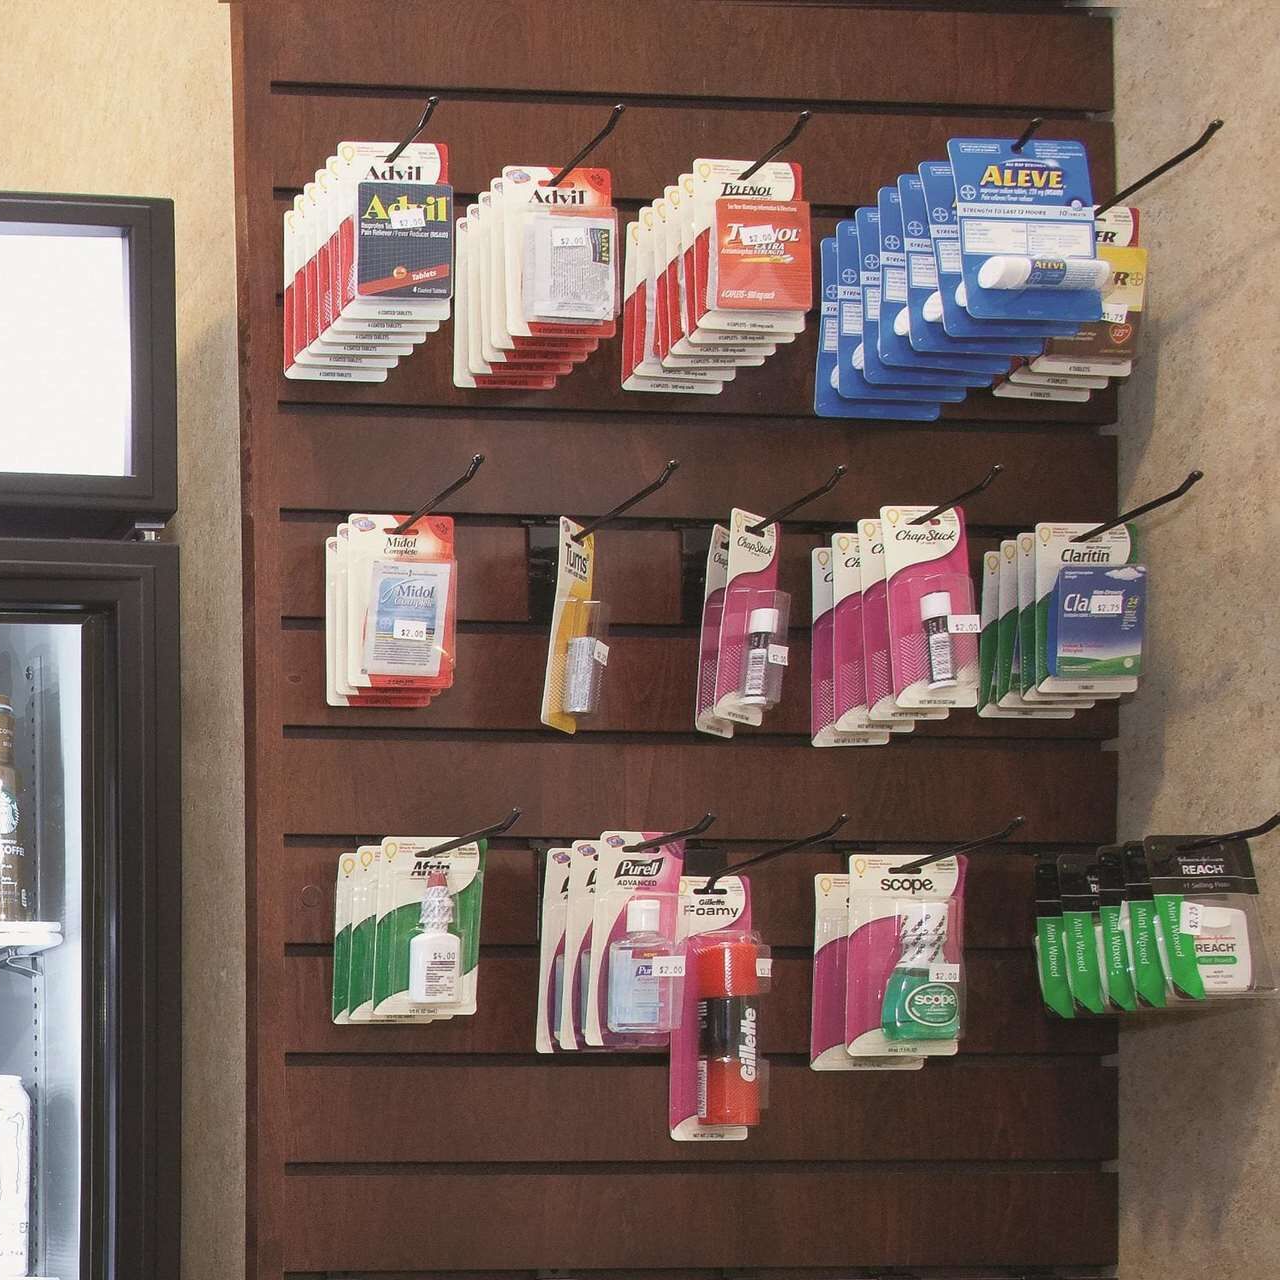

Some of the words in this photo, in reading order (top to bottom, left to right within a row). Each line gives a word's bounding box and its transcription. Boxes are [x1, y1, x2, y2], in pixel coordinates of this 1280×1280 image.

[364, 166, 422, 180] Advil
[980, 166, 1064, 190] ALEVE
[529, 190, 584, 204] Advil
[720, 183, 774, 198] TYLENOL
[1034, 260, 1065, 270] ALEVE
[411, 270, 437, 281] Tablets
[386, 537, 417, 548] Midol
[895, 530, 956, 542] ChapStick
[736, 536, 772, 557] ChapStick
[565, 543, 588, 574] Tums
[1061, 549, 1110, 563] Claritin
[396, 585, 435, 600] Midol
[1097, 603, 1119, 612] $2.75
[401, 629, 424, 638] $2.00
[954, 623, 978, 631] $2.00
[1182, 864, 1223, 875] REACH
[617, 879, 657, 887] ADVANCED
[880, 877, 933, 894] scope
[683, 903, 739, 919] Foamy
[1194, 943, 1235, 954] REACH
[433, 952, 455, 960] $4.00
[1050, 942, 1059, 977] Waxed
[659, 965, 683, 975] $2.00
[935, 972, 957, 981] $2.00
[914, 993, 955, 1009] scope
[740, 1007, 757, 1083] Gillette
